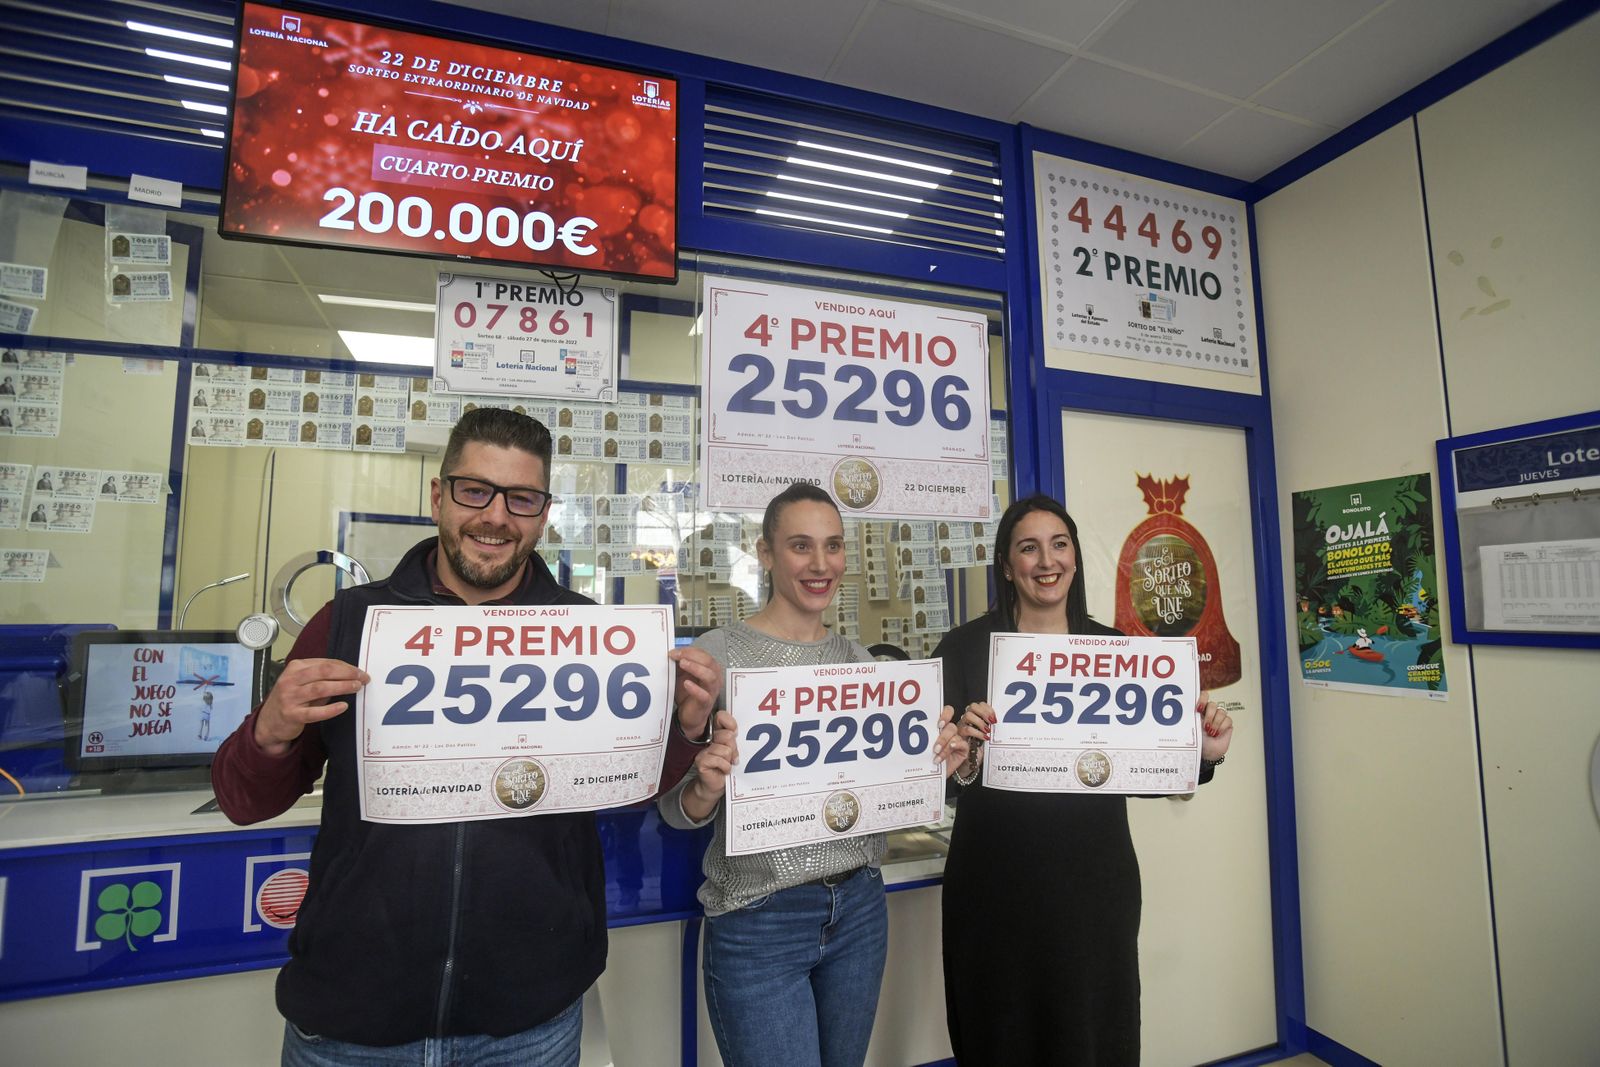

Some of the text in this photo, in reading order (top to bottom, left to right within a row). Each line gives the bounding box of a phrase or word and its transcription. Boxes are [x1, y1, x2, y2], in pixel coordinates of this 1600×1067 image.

[250, 28, 329, 48] LOTERÍA NACIONAL
[380, 51, 563, 93] 22 DE DICIEMBRE
[348, 64, 590, 111] SORTEO EXTRAORDINARIO DE NAVIDAD
[632, 94, 671, 107] LOTERÍAS
[351, 111, 585, 163] HA CAÍDO AQUÍ
[35, 169, 66, 180] MURCIA
[380, 155, 555, 192] CUARTO PREMIO
[134, 186, 163, 197] MADRID
[319, 187, 599, 256] 200.000€
[1068, 196, 1223, 261] 44469
[1073, 246, 1223, 301] 2º PREMIO
[495, 283, 584, 307] PREMIO
[454, 301, 593, 338] 07861
[814, 301, 896, 320] VENDIDO AQUÍ
[1128, 321, 1148, 331] SORTEO
[743, 314, 957, 368] 4º PREMIO
[496, 361, 558, 373] Lotería Nacional
[726, 353, 973, 431] 25296
[1519, 469, 1560, 484] JUEVES
[904, 483, 966, 494] 22 DICIEMBRE
[1342, 506, 1372, 514] BONOLOTO
[1325, 512, 1389, 544] OJALÁ
[1327, 542, 1393, 561] BONOLOTO,
[1336, 559, 1359, 568] JUEGO
[1359, 556, 1375, 564] QUE
[1375, 553, 1391, 561] MÁS
[1143, 561, 1192, 592] SORTEO
[1327, 564, 1374, 576] OPORTUNIDADES
[1155, 579, 1192, 598] QUE NOS
[483, 607, 569, 618] VENDIDO AQUÍ
[1151, 596, 1184, 625] UNE
[404, 625, 636, 657] 4º PREMIO
[1069, 638, 1130, 647] VENDIDO AQUÍ
[133, 647, 164, 664] CON
[132, 665, 148, 683] EL
[813, 665, 877, 678] VENDIDO AQUÍ
[1016, 652, 1176, 679] 4º PREMIO
[1407, 663, 1440, 671] CONSIGUE
[1407, 669, 1441, 677] GRANDES
[130, 685, 176, 701] JUEGO
[381, 662, 652, 727] 25296
[758, 679, 921, 717] 4º PREMIO
[130, 702, 173, 719] NO SE
[1002, 680, 1184, 727] 25296
[128, 719, 172, 738] JUEGA
[744, 709, 930, 774] 25296
[503, 772, 538, 789] SORTEO
[573, 772, 639, 786] 22 DICIEMBRE
[1140, 767, 1179, 775] DICIEMBRE
[511, 790, 531, 804] UNE
[887, 798, 925, 811] DICIEMBRE
